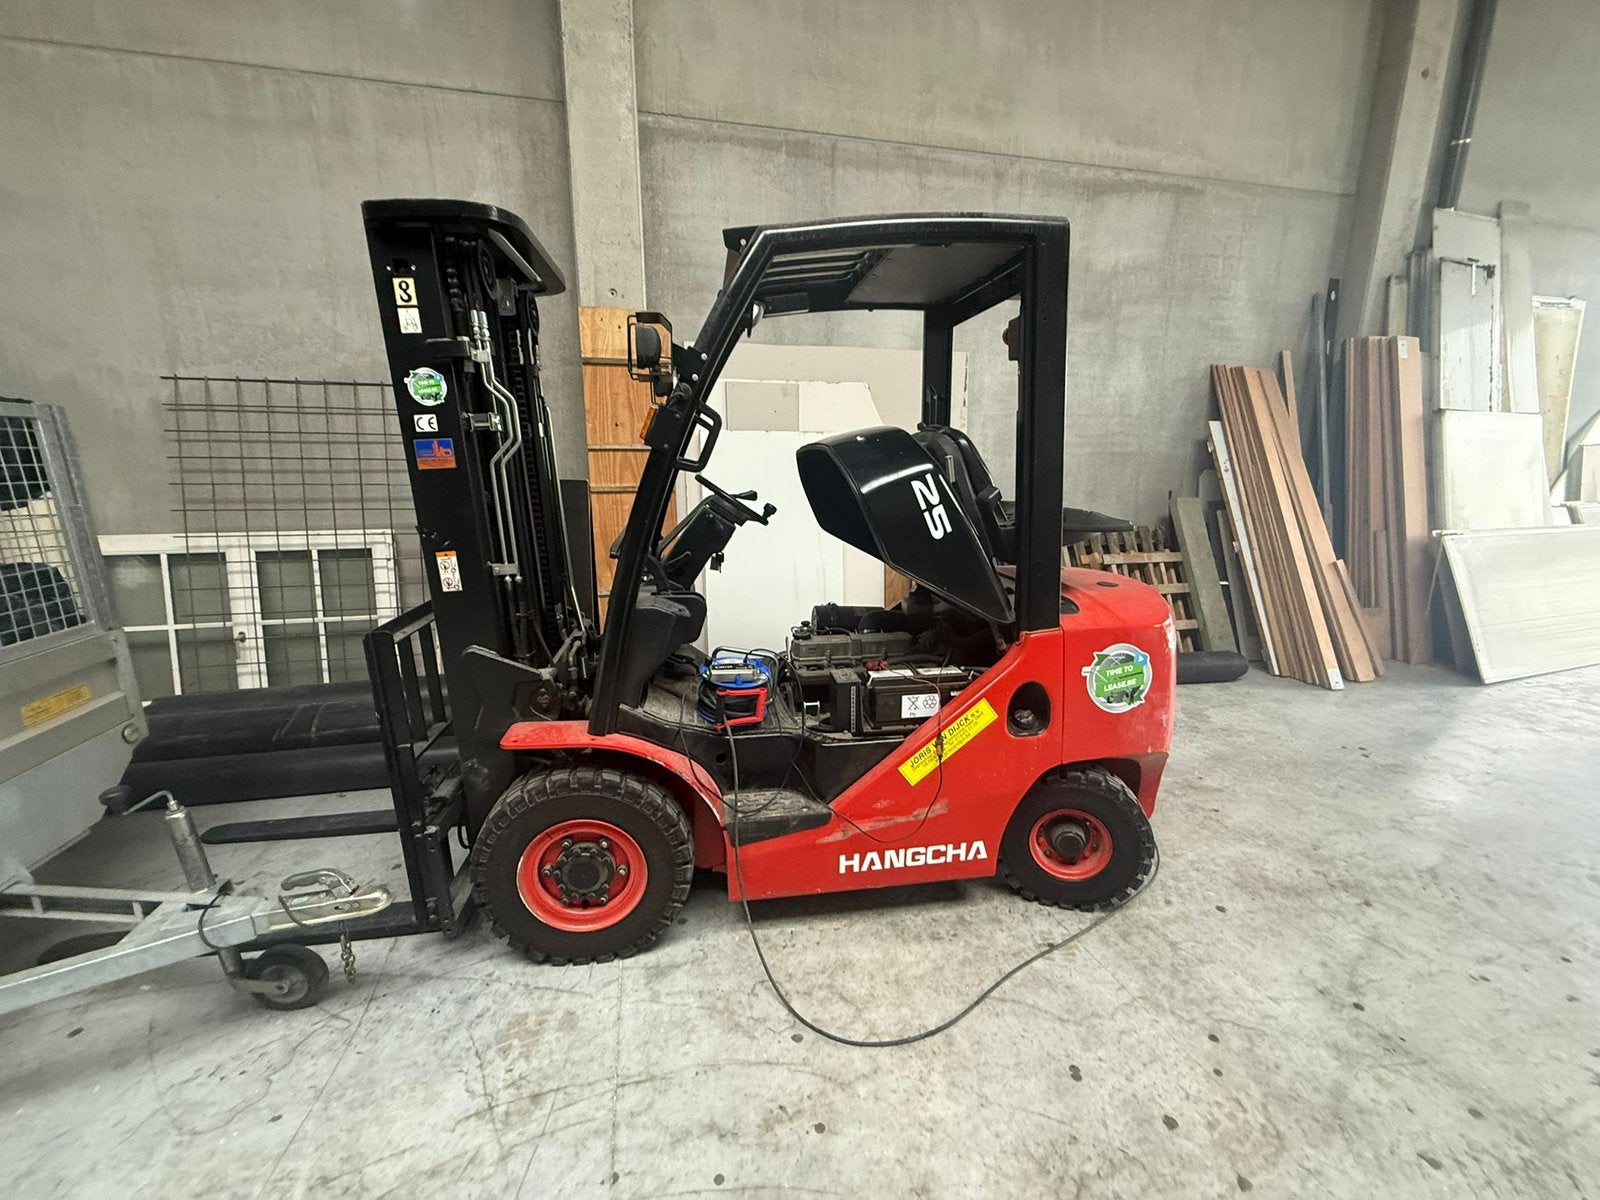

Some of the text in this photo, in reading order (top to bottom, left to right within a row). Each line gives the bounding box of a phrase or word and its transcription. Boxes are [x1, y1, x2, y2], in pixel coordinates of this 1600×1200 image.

[416, 416, 437, 430] CE
[910, 473, 952, 540] 25
[1105, 665, 1134, 677] TIME TO
[1103, 678, 1137, 691] LEASE.BE
[910, 746, 931, 768] JORIS
[932, 733, 947, 748] VN
[948, 715, 970, 736] DIJCK
[838, 840, 988, 874] HANGCHA
